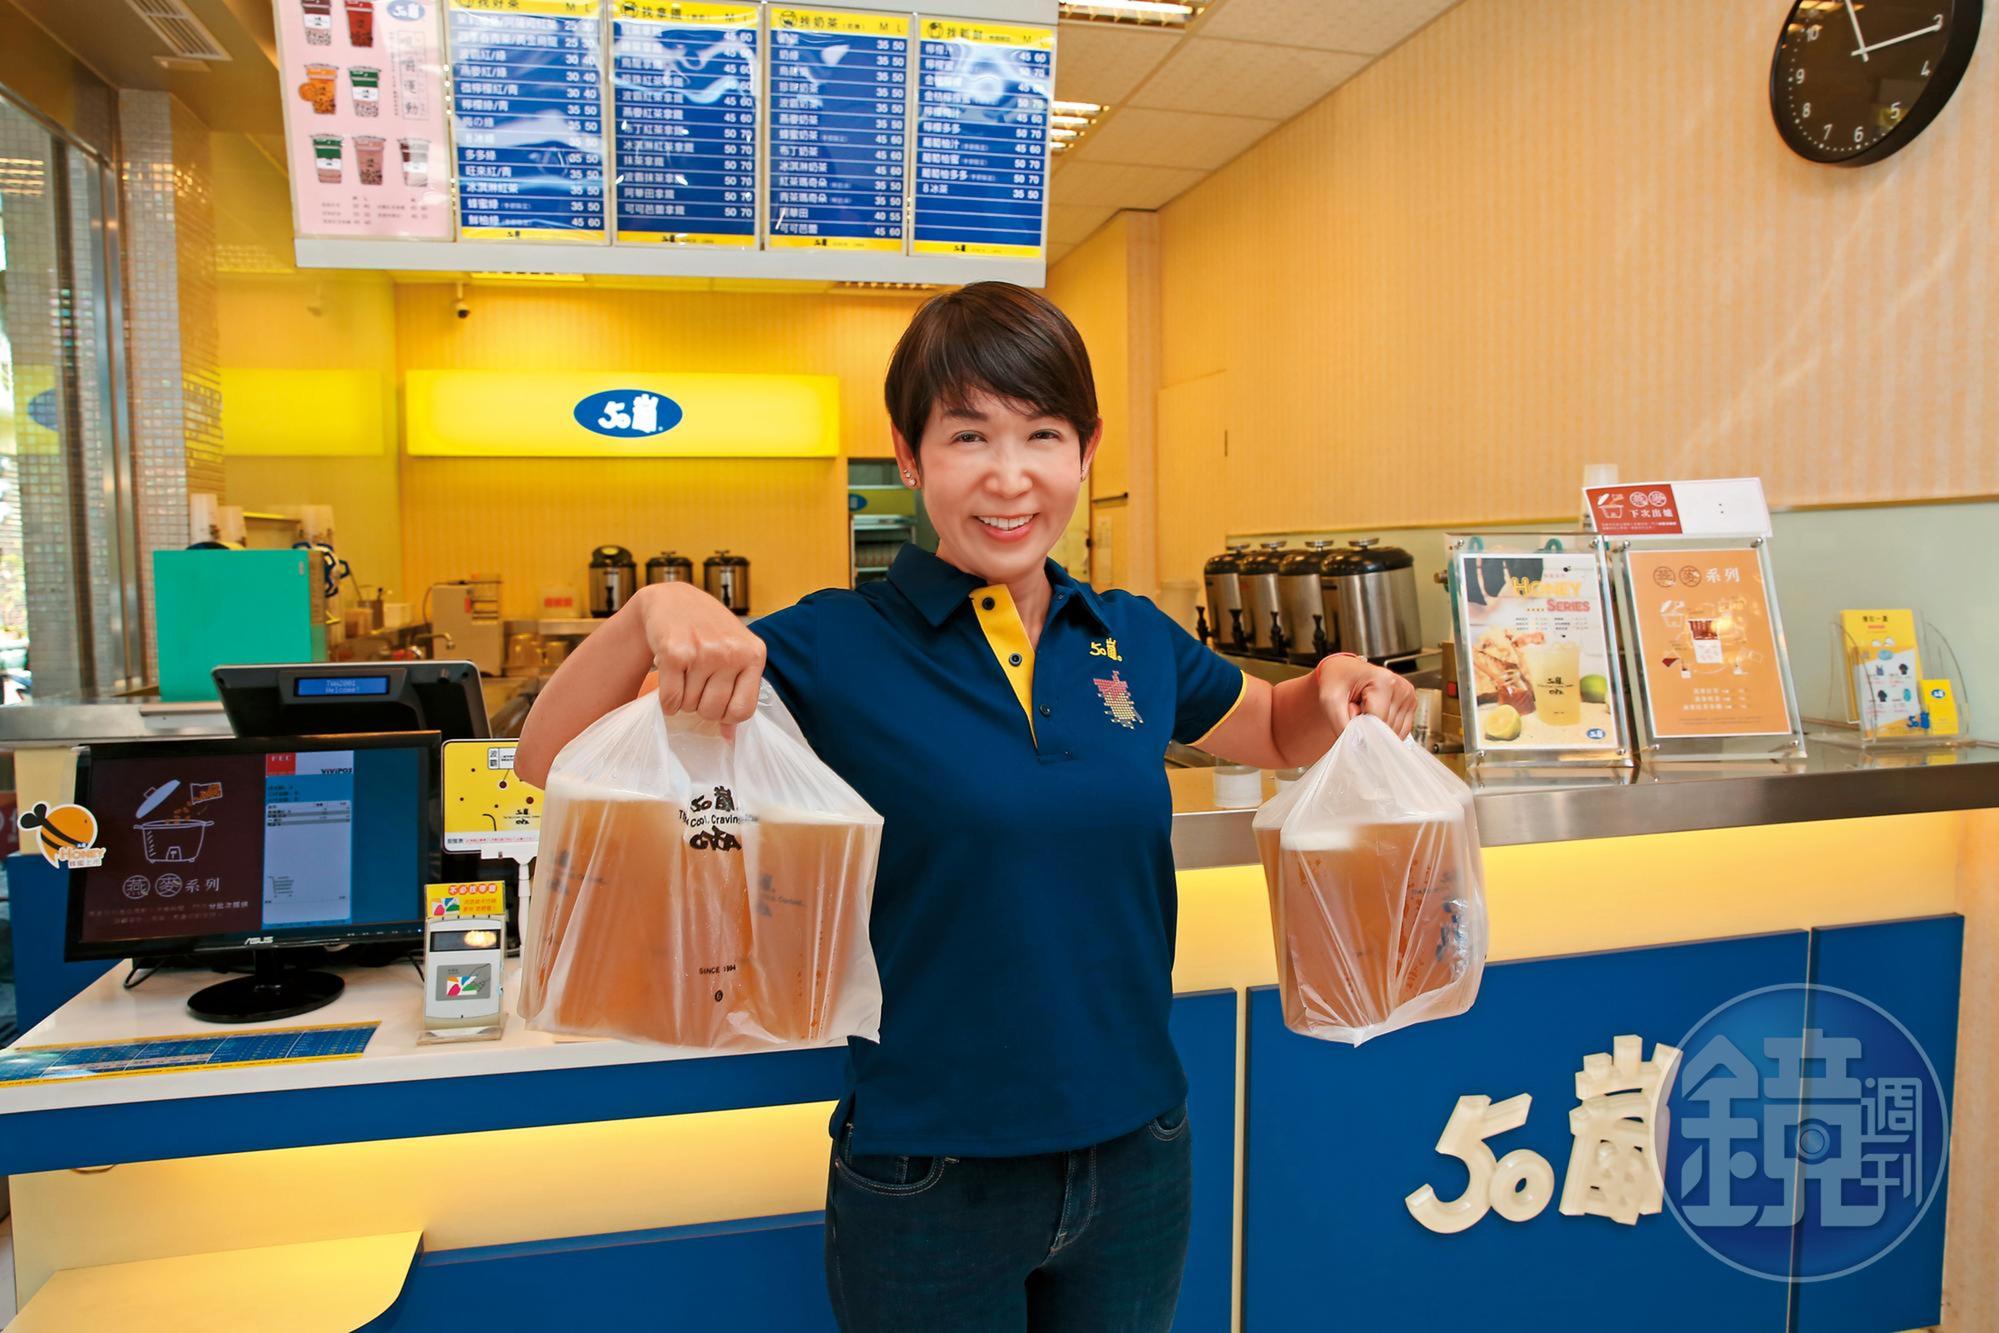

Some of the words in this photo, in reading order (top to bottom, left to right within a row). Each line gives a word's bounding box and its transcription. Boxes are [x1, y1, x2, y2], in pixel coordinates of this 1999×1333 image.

[879, 22, 889, 31] M
[565, 37, 578, 48] 25
[740, 32, 753, 43] 60
[876, 40, 889, 50] 35
[892, 40, 905, 51] 50
[566, 53, 579, 65] 30
[582, 54, 596, 66] 40
[876, 55, 889, 66] 35
[892, 56, 904, 67] 50
[1034, 52, 1046, 63] 60
[724, 64, 737, 74] 45
[1921, 60, 1931, 78] 4
[567, 71, 580, 82] 30
[583, 72, 596, 83] 40
[876, 71, 889, 82] 35
[892, 71, 904, 83] 50
[1796, 69, 1805, 84] 9
[567, 87, 580, 98] 30
[583, 88, 597, 99] 40
[876, 87, 888, 98] 35
[892, 88, 904, 98] 50
[724, 96, 737, 106] 45
[740, 96, 753, 107] 60
[568, 104, 580, 115] 35
[584, 105, 597, 116] 50
[876, 103, 888, 113] 35
[891, 103, 904, 114] 50
[1802, 102, 1812, 118] 8
[1890, 101, 1901, 119] 5
[724, 112, 736, 123] 45
[740, 113, 753, 123] 60
[1016, 112, 1029, 123] 45
[1031, 113, 1043, 124] 60
[569, 120, 581, 131] 35
[585, 121, 598, 132] 50
[876, 119, 888, 129] 35
[891, 119, 903, 130] 50
[724, 128, 737, 139] 50
[740, 129, 752, 140] 70
[1015, 128, 1028, 138] 50
[1030, 128, 1042, 139] 70
[1823, 123, 1833, 141] 7
[1854, 126, 1864, 142] 6
[875, 134, 888, 145] 45
[891, 135, 903, 145] 60
[724, 144, 737, 155] 50
[740, 145, 752, 155] 70
[1015, 143, 1027, 154] 45
[1029, 144, 1041, 155] 60
[586, 153, 598, 164] 50
[875, 150, 887, 160] 45
[890, 150, 903, 161] 60
[724, 160, 737, 170] 50
[740, 160, 753, 171] 70
[1014, 158, 1027, 169] 50
[1028, 159, 1041, 170] 70
[570, 169, 582, 180] 35
[586, 170, 599, 181] 50
[875, 165, 887, 176] 45
[890, 166, 903, 176] 60
[724, 175, 737, 186] 50
[740, 176, 753, 187] 70
[1013, 173, 1026, 184] 50
[1028, 174, 1040, 185] 70
[571, 185, 583, 196] 35
[587, 185, 599, 196] 50
[874, 181, 887, 191] 35
[890, 181, 902, 191] 50
[724, 191, 737, 202] 50
[1012, 188, 1025, 199] 35
[1027, 189, 1039, 200] 50
[571, 201, 583, 212] 35
[588, 202, 600, 212] 50
[874, 196, 887, 206] 35
[890, 196, 902, 206] 50
[725, 207, 737, 217] 50
[740, 207, 752, 218] 70
[874, 211, 887, 221] 40
[889, 211, 901, 221] 55
[572, 217, 584, 228] 45
[588, 218, 600, 228] 60
[874, 226, 886, 237] 45
[889, 227, 901, 237] 60
[598, 393, 659, 433] 50嵐
[1511, 577, 1582, 600] HONEY
[1089, 637, 1117, 661] 50嵐
[690, 785, 735, 812] 50嵐
[122, 873, 220, 900] 燕麥系列
[244, 936, 274, 946] ASUS
[699, 966, 720, 976] SINCE
[1404, 1033, 1684, 1234] 50嵐
